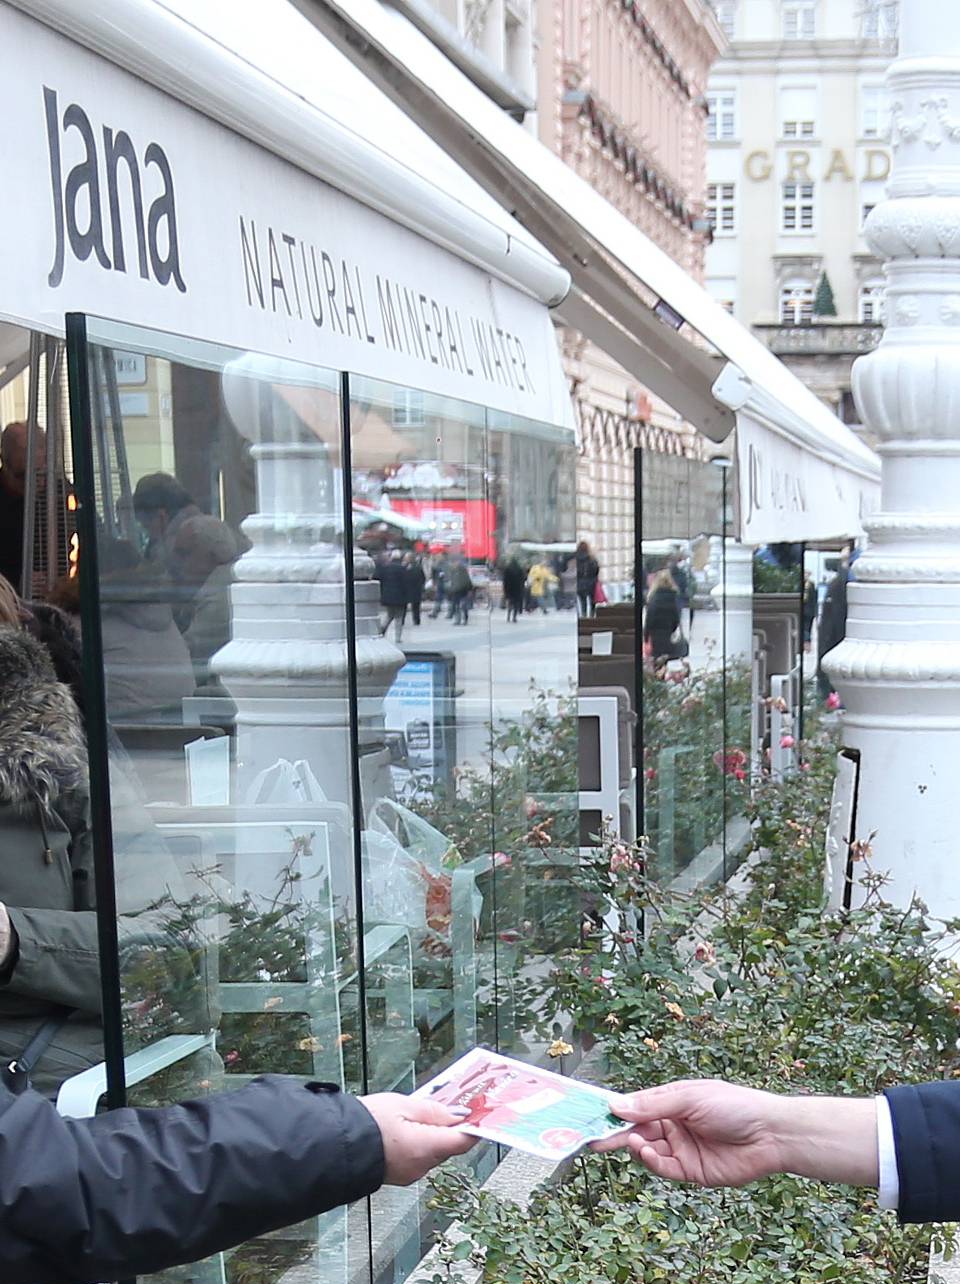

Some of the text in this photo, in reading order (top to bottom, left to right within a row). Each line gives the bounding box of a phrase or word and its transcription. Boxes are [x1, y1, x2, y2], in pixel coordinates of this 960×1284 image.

[239, 215, 376, 344] NATURAL
[376, 274, 474, 377] MINERAL
[470, 316, 537, 395] WATER
